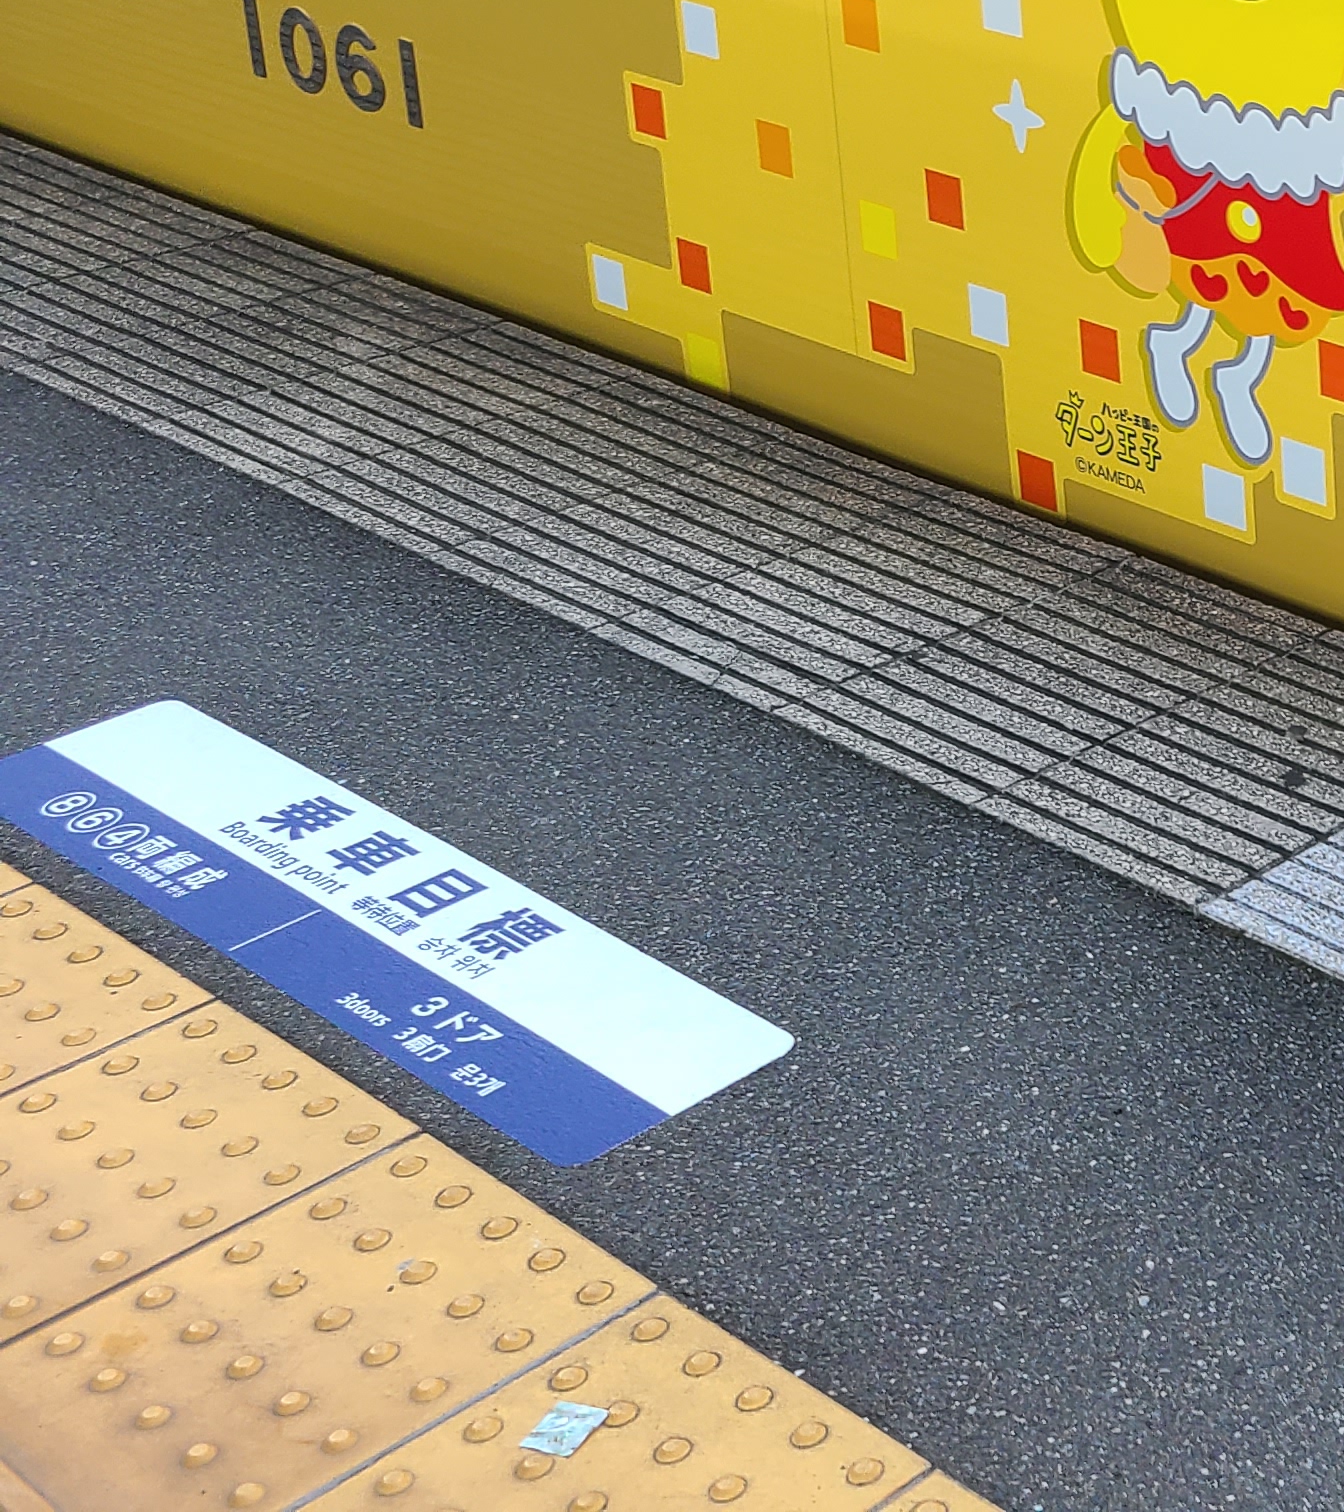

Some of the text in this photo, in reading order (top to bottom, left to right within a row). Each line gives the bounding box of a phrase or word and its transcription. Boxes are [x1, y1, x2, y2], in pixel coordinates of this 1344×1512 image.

[1055, 400, 1162, 472] ターン王子
[108, 851, 141, 870] cars
[219, 821, 352, 896] Boarding point
[256, 795, 566, 961] 乗車目標
[350, 894, 421, 937] 等待位置
[416, 937, 497, 980] 승차 위치
[335, 992, 393, 1027] 3doors
[410, 996, 505, 1043] 3ドア
